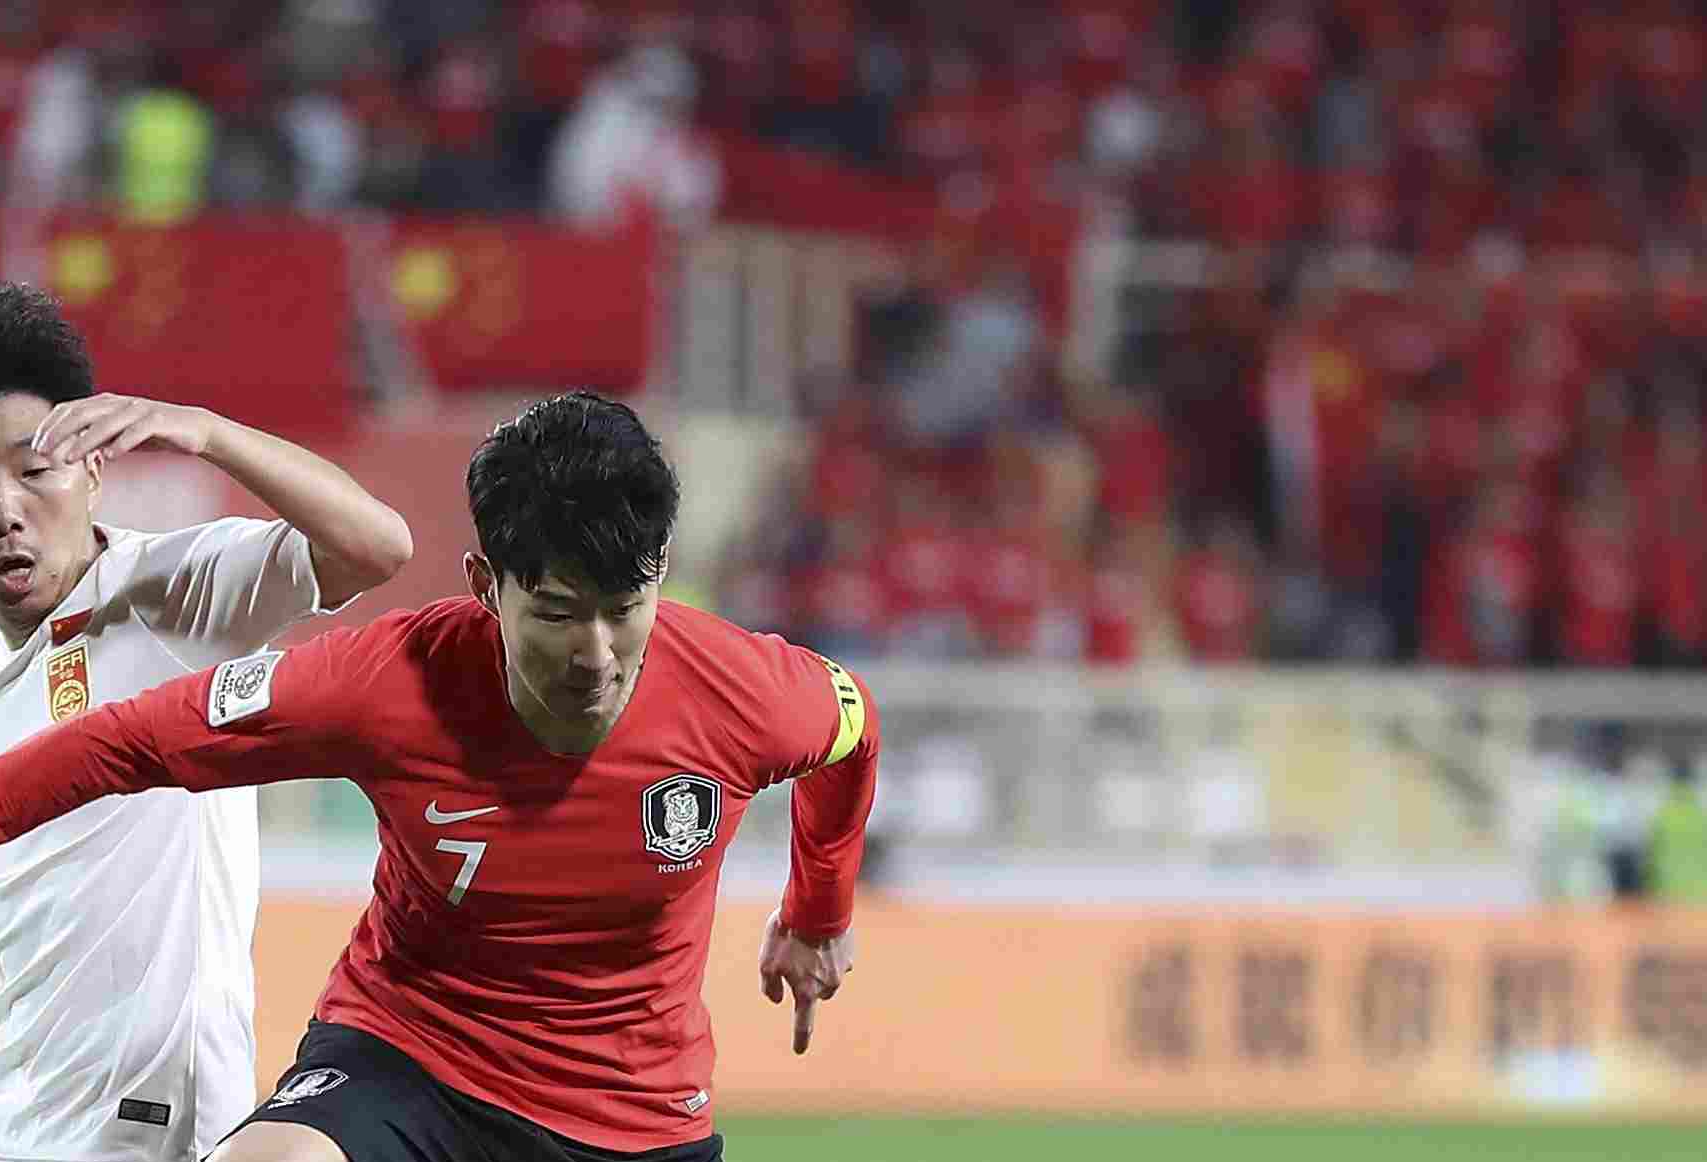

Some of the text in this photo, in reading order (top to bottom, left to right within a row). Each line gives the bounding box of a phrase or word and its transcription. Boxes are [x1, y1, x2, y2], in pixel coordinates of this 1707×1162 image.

[48, 649, 84, 676] CFA
[435, 838, 487, 906] 7
[658, 858, 704, 873] KOREA
